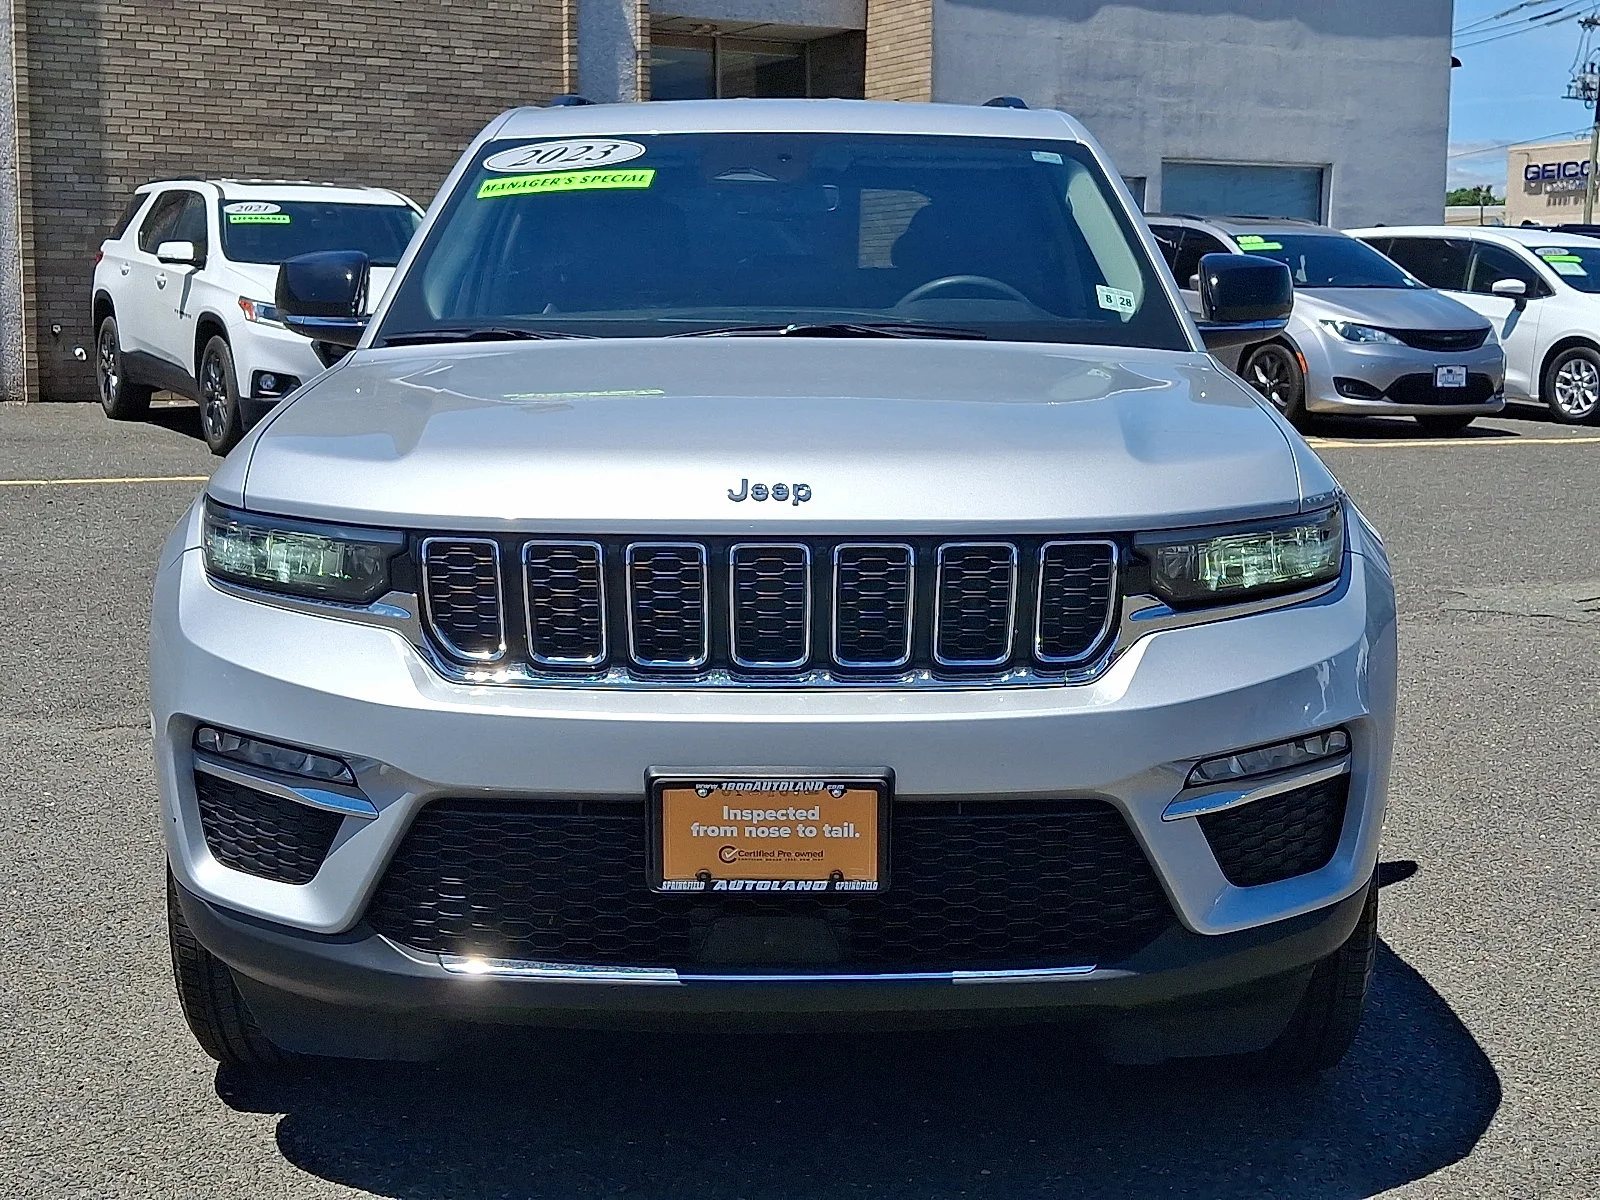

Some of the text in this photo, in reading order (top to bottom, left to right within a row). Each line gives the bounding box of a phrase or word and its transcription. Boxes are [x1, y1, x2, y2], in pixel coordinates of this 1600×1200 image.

[507, 144, 621, 168] 2023
[1524, 161, 1598, 180] GEICO
[483, 173, 648, 193] MANAGER'S SPECIAL
[1106, 295, 1132, 307] 8 28
[727, 478, 812, 507] Jeep
[723, 805, 820, 824] Inspected
[690, 822, 860, 838] from nose to tail.
[738, 850, 775, 858] Certified
[662, 880, 878, 891] SPRINGFIELD AUTOLAND SPRINGFIELD
